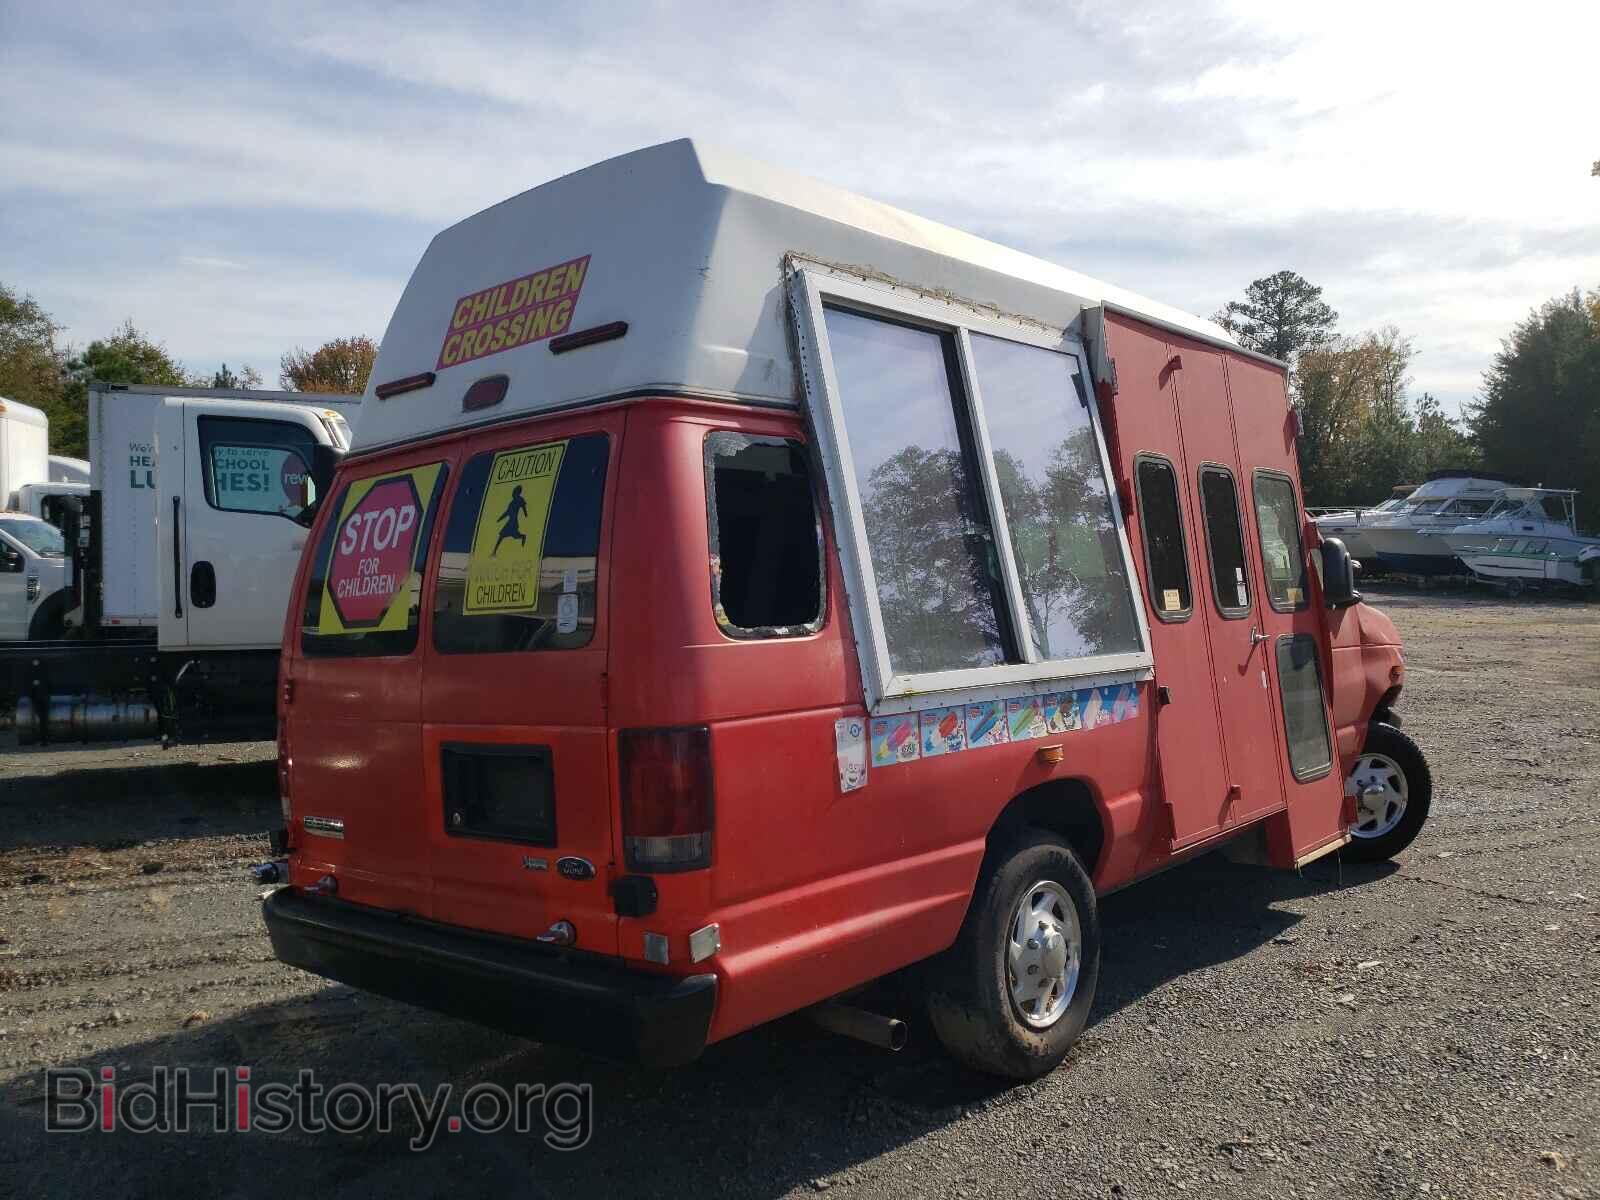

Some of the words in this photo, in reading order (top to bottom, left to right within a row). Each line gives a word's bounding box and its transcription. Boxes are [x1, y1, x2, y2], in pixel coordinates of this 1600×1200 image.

[453, 260, 588, 329] CHILDREN
[442, 299, 572, 365] CROSSING
[497, 450, 557, 480] CAUTION
[341, 504, 415, 555] STOP
[358, 558, 380, 575] FOR
[337, 574, 395, 599] CHILDREN
[476, 583, 526, 605] CHILDREN
